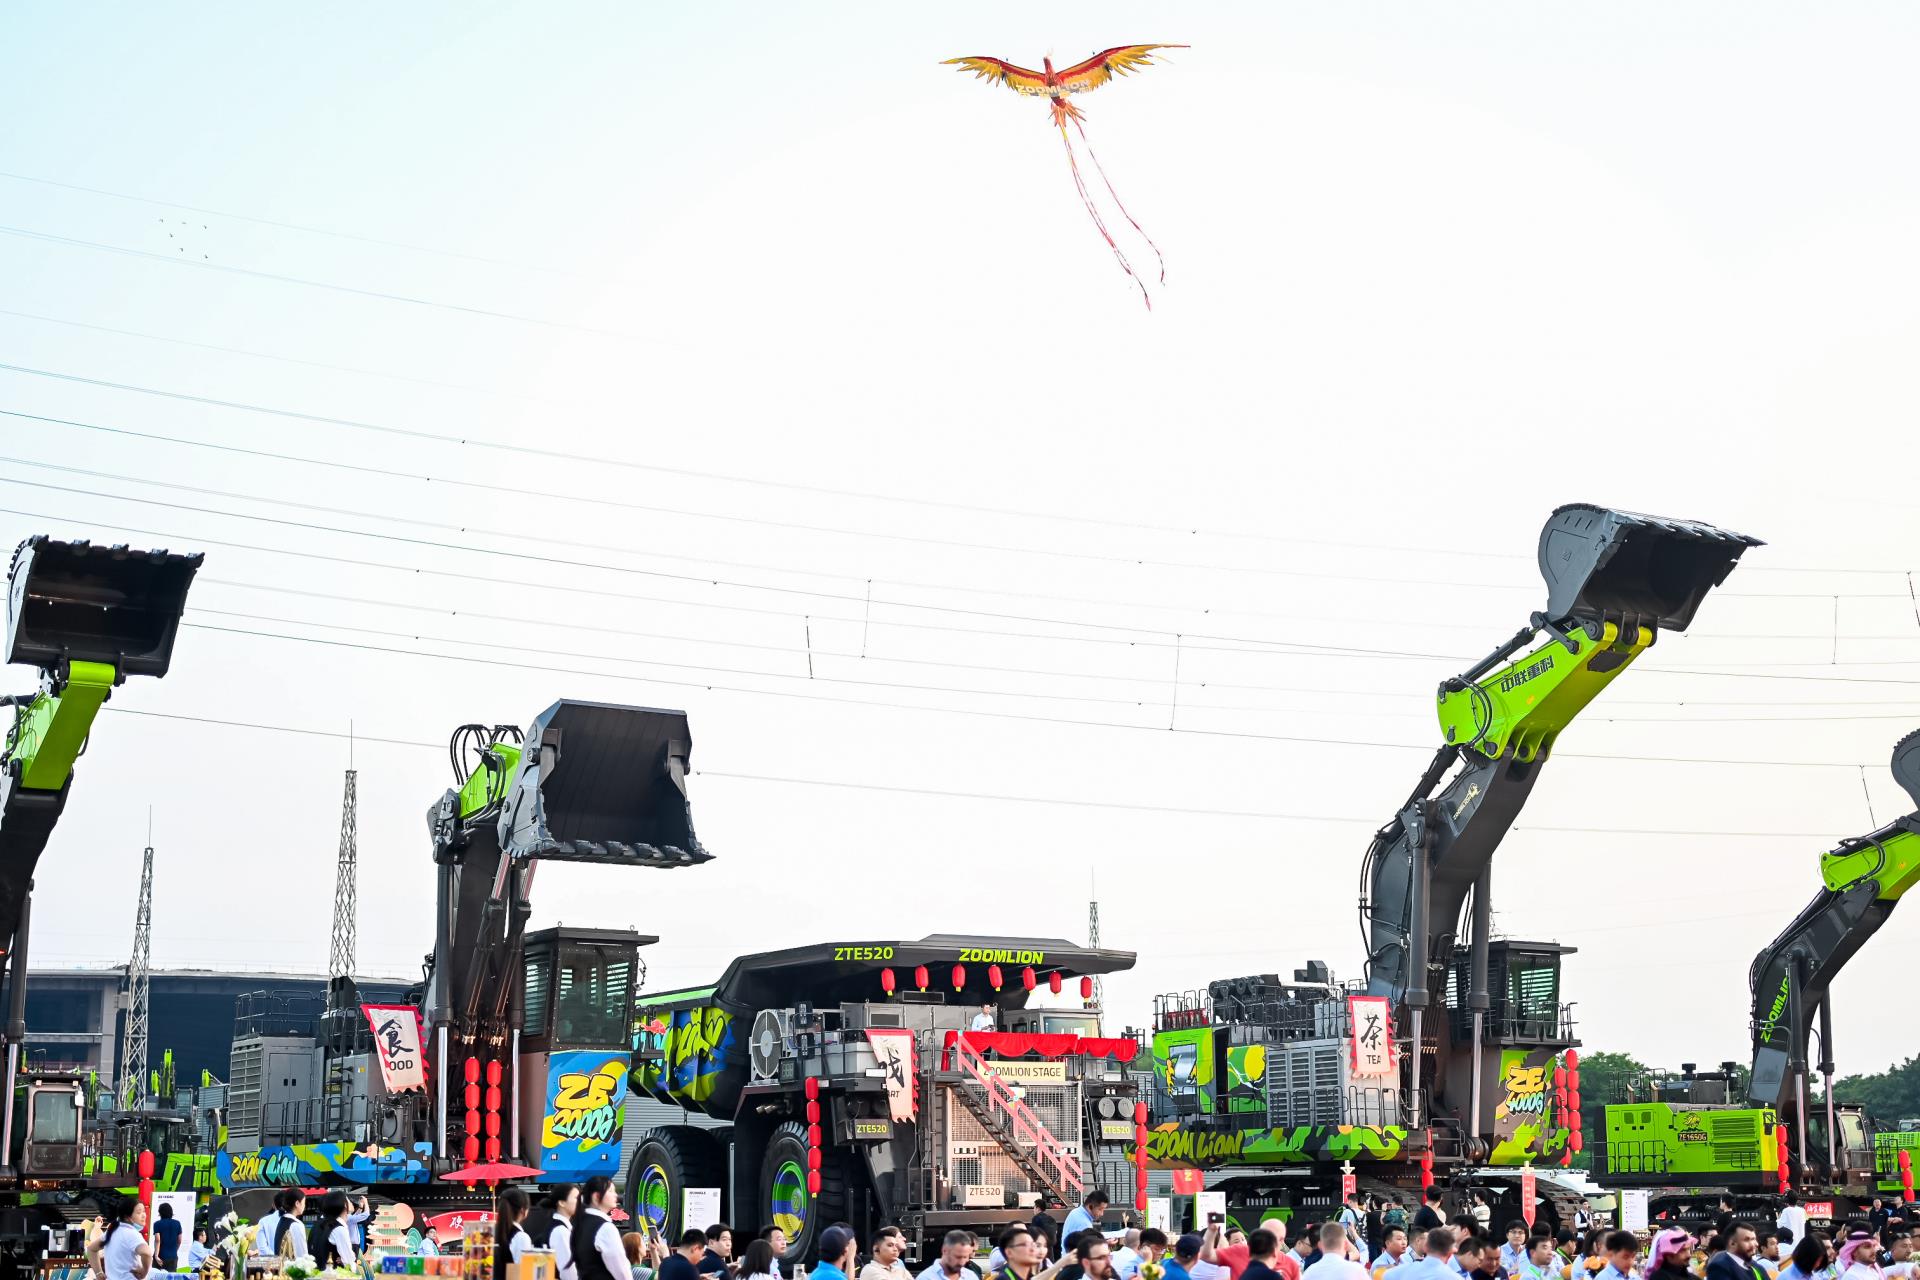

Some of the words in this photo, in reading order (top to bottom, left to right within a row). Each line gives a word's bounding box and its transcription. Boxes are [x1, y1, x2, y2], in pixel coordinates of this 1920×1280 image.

[1501, 655, 1554, 693] 中联重科
[834, 946, 893, 961] ZTE520
[959, 948, 1043, 964] ZOOMLION
[1760, 976, 1788, 1043] ZOOMLIO
[378, 1019, 414, 1058] 食
[1361, 1014, 1383, 1051] 茶
[390, 1060, 413, 1071] OOD
[1366, 1055, 1381, 1064] TEA
[1033, 1067, 1061, 1077] STAGE
[552, 1105, 617, 1141] 2000G
[857, 1124, 887, 1133] ZTE520
